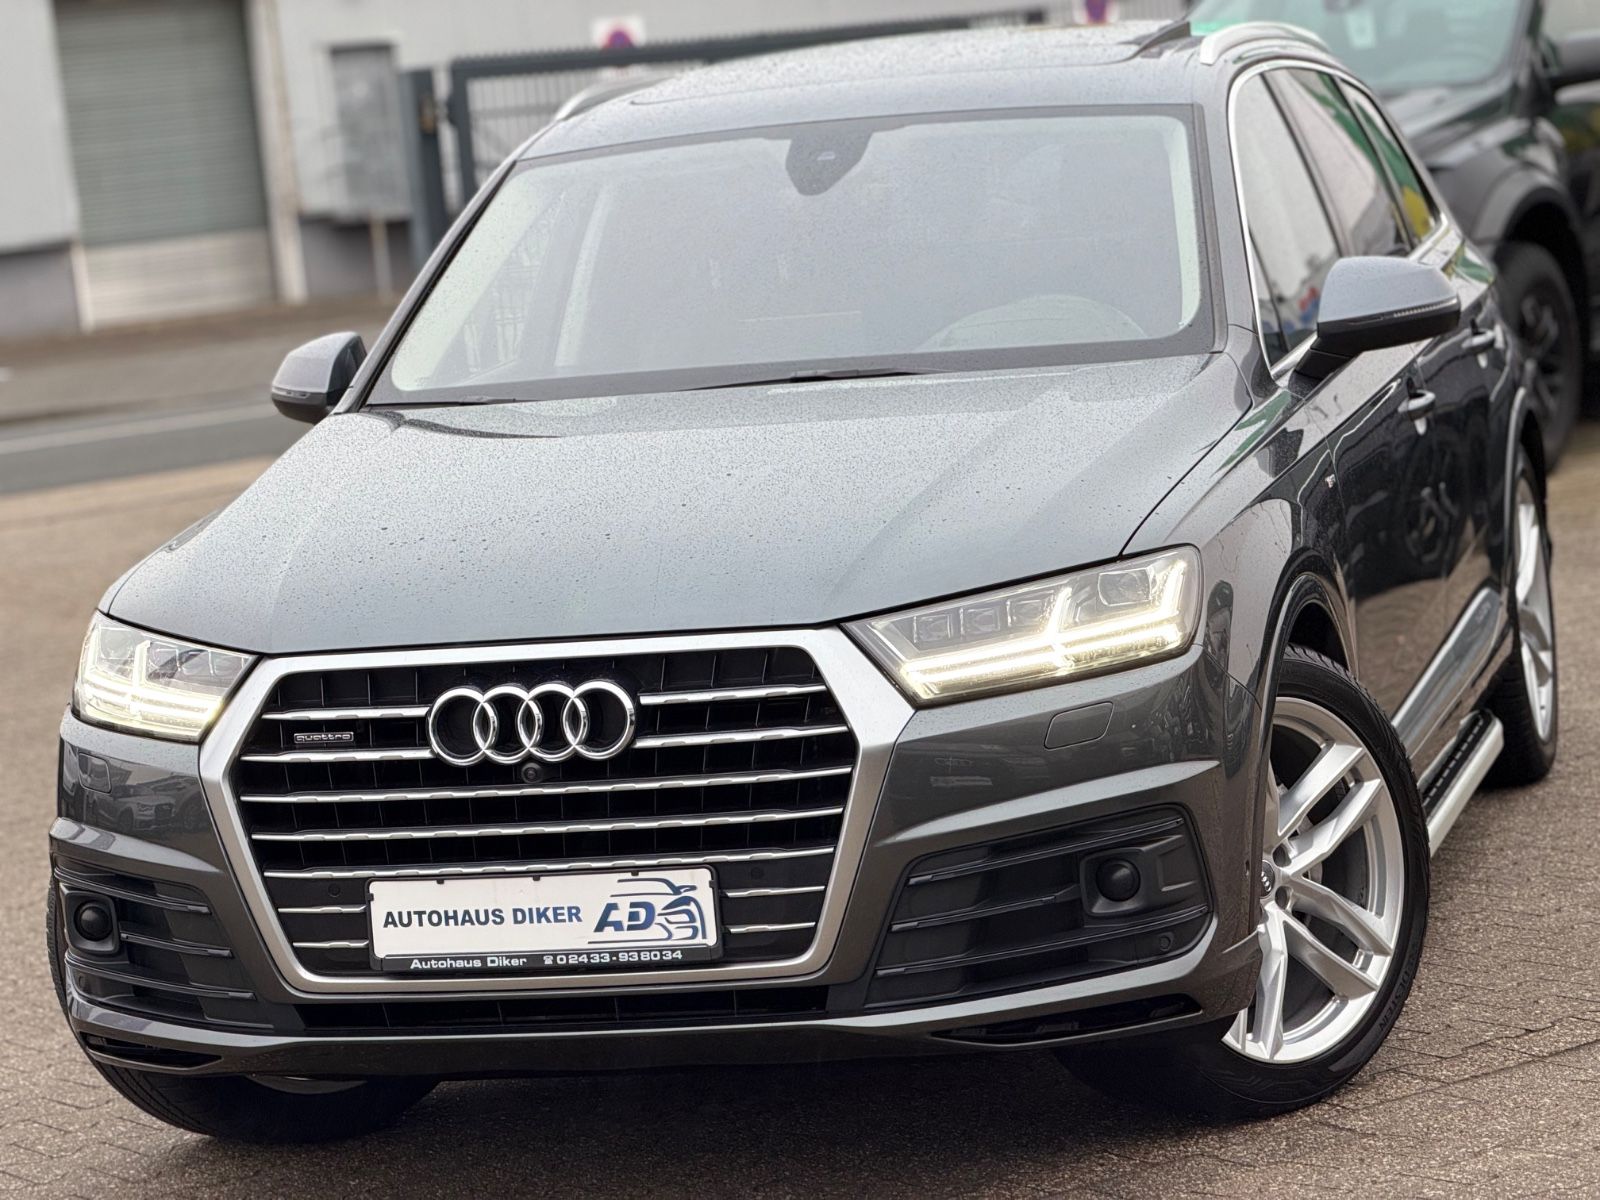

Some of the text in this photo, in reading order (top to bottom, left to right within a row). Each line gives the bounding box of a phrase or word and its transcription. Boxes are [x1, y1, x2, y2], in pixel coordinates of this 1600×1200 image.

[296, 734, 351, 742] quattro
[383, 905, 583, 928] AUTOHAUS DIKER
[593, 901, 656, 933] AD
[410, 950, 683, 969] Autohaus Diker 02433-938034
